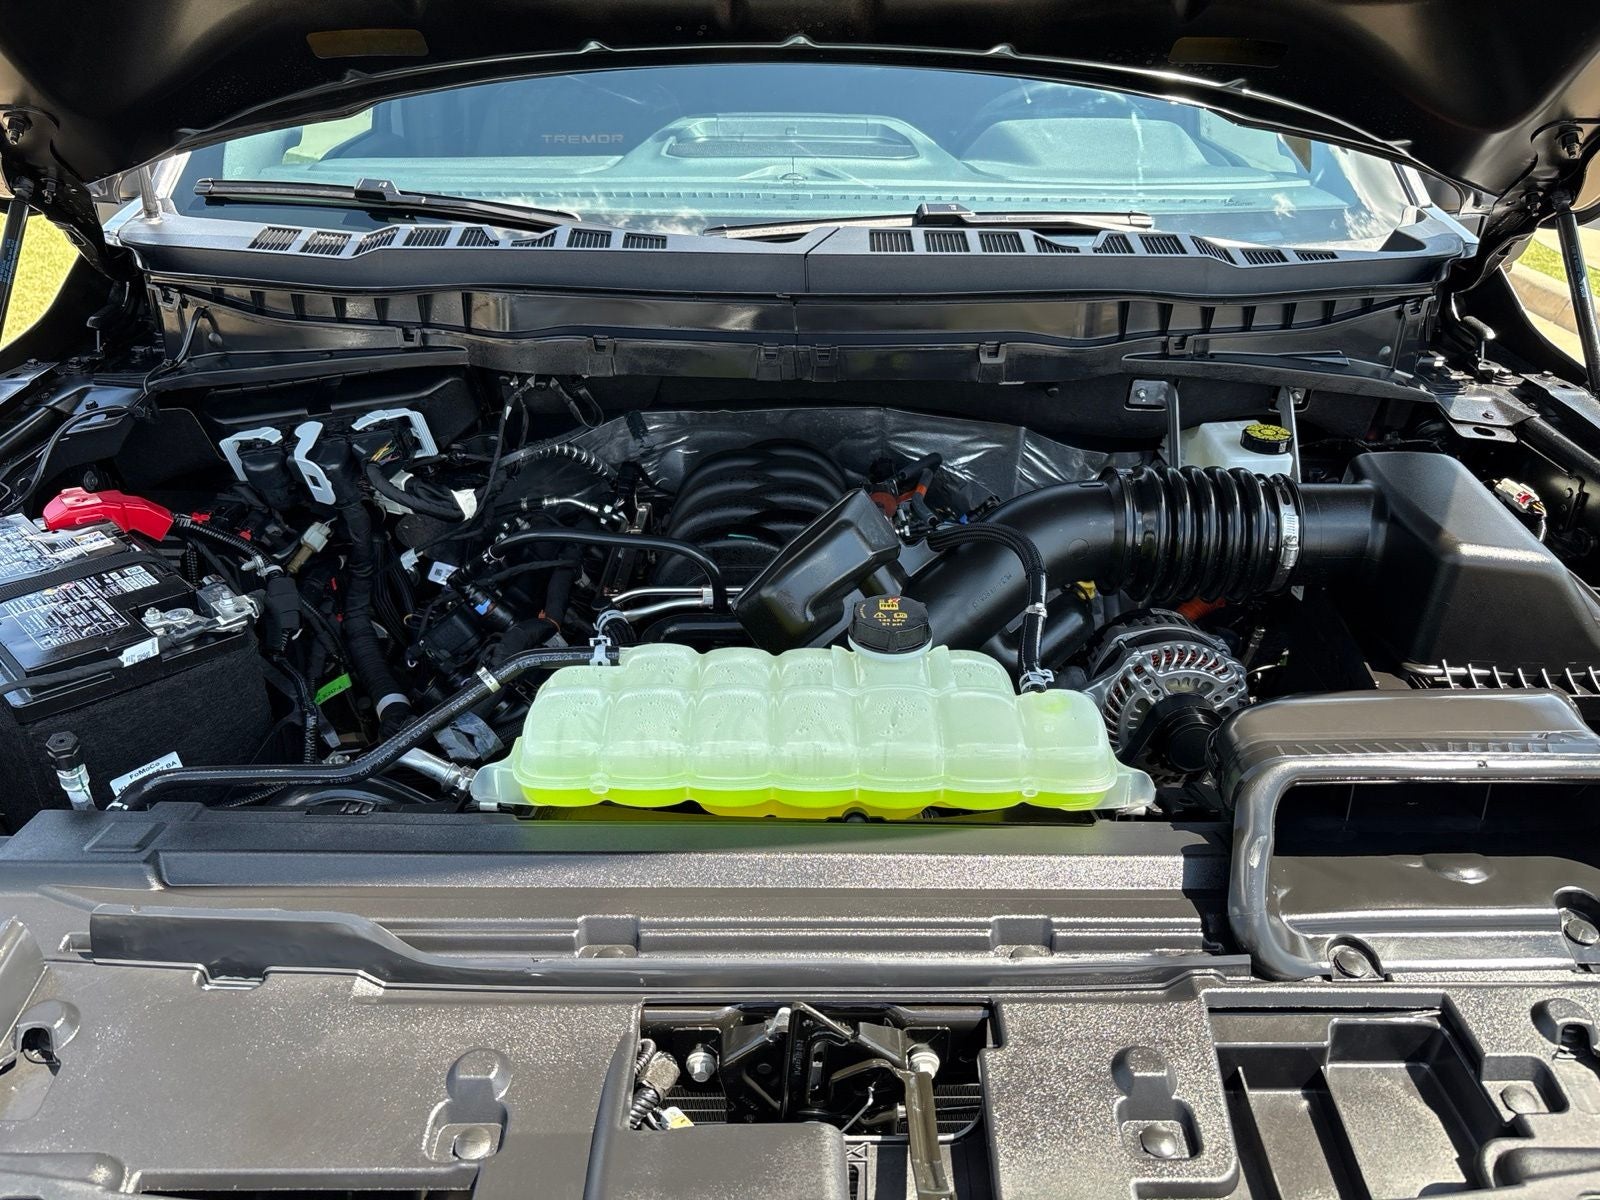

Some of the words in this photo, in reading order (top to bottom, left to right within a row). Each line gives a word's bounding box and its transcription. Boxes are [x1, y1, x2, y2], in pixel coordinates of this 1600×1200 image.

[541, 134, 624, 144] TREMOR
[166, 760, 177, 769] BA
[129, 762, 160, 779] FoMoCo
